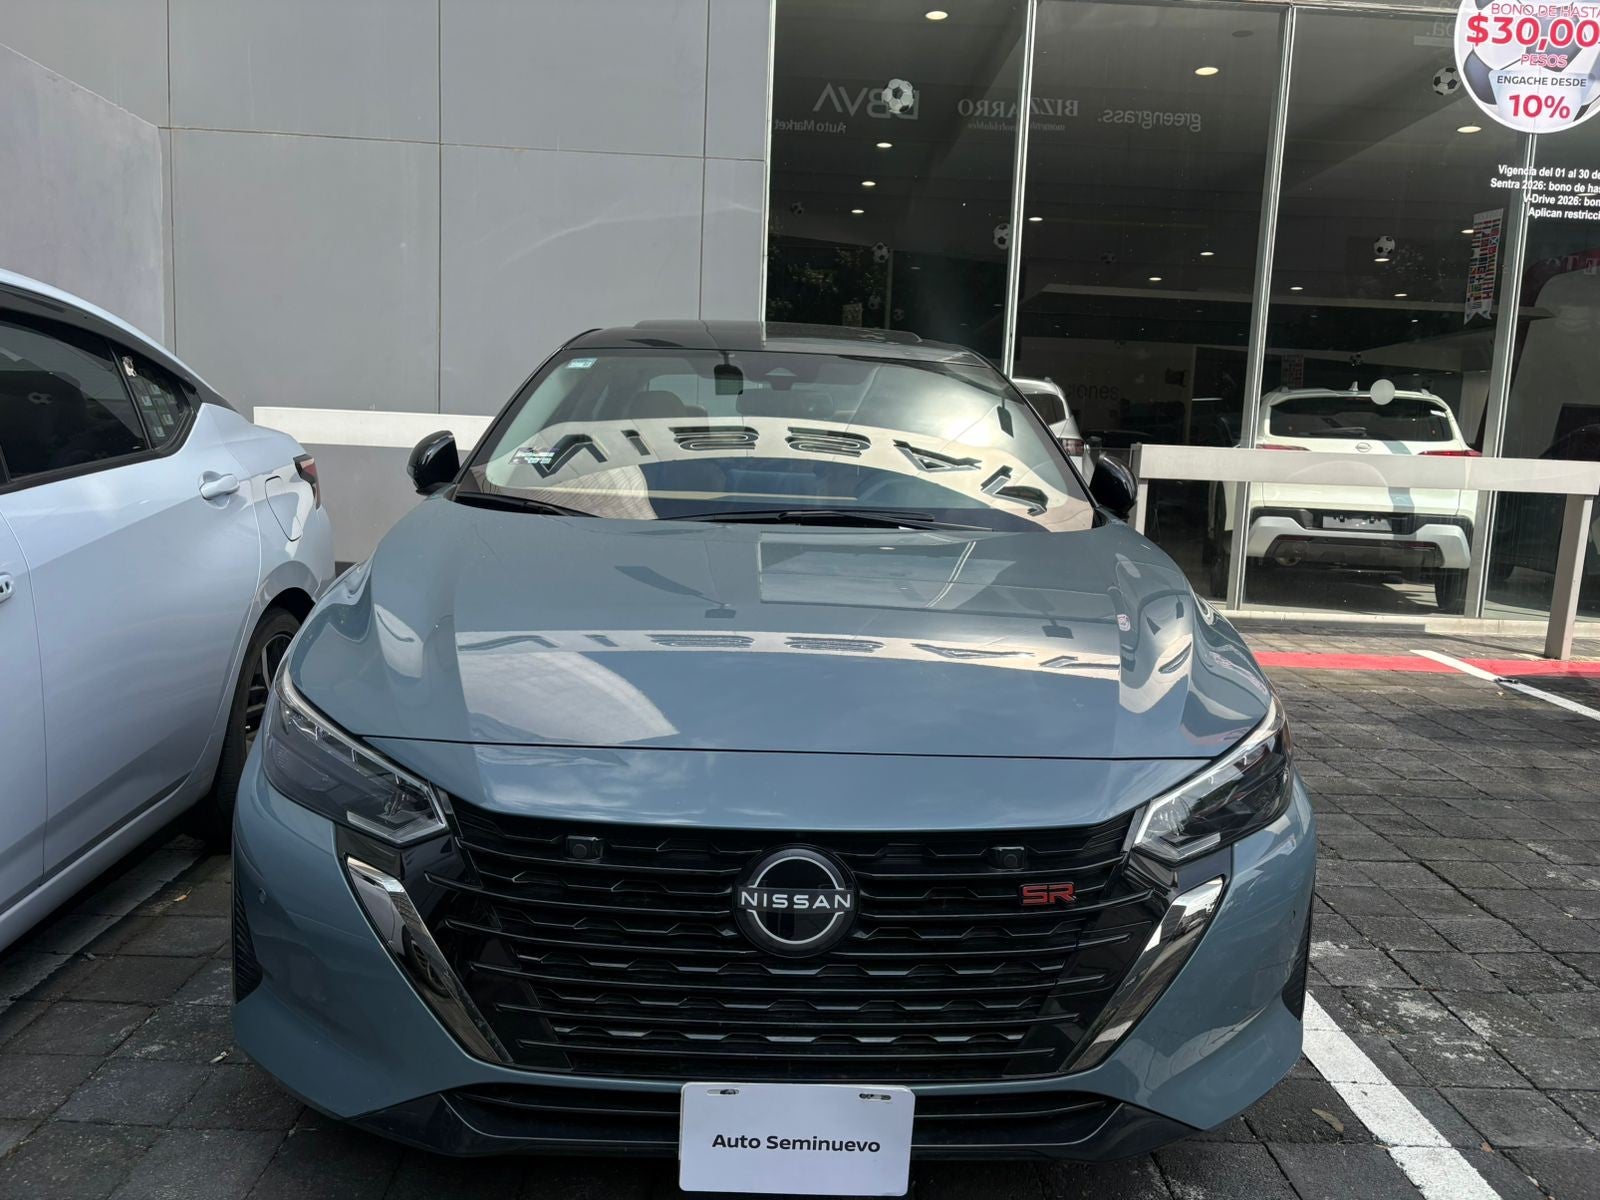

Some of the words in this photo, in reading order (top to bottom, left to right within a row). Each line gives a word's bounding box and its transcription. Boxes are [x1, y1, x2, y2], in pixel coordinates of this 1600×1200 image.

[1491, 3, 1534, 16] BONO
[1538, 5, 1557, 17] DE
[1466, 12, 1600, 51] $30,00
[1520, 54, 1568, 67] PESOS
[1496, 75, 1548, 86] ENGACHE
[1550, 77, 1587, 87] DESDE
[1508, 94, 1571, 119] 10%
[1498, 164, 1537, 177] Vigencia
[1539, 167, 1553, 177] del
[1555, 167, 1566, 178] 01
[1568, 168, 1577, 178] al
[1578, 169, 1590, 179] 30
[1490, 178, 1520, 189] Sentra
[1521, 181, 1546, 191] 2026:
[1549, 181, 1572, 192] bono
[1574, 183, 1586, 193] de
[1557, 195, 1581, 206] 2026:
[1527, 207, 1562, 219] Aplican
[740, 890, 852, 909] NISSAN
[1020, 882, 1075, 905] SR
[712, 1134, 761, 1150] Auto
[766, 1135, 881, 1153] Seminuevo
